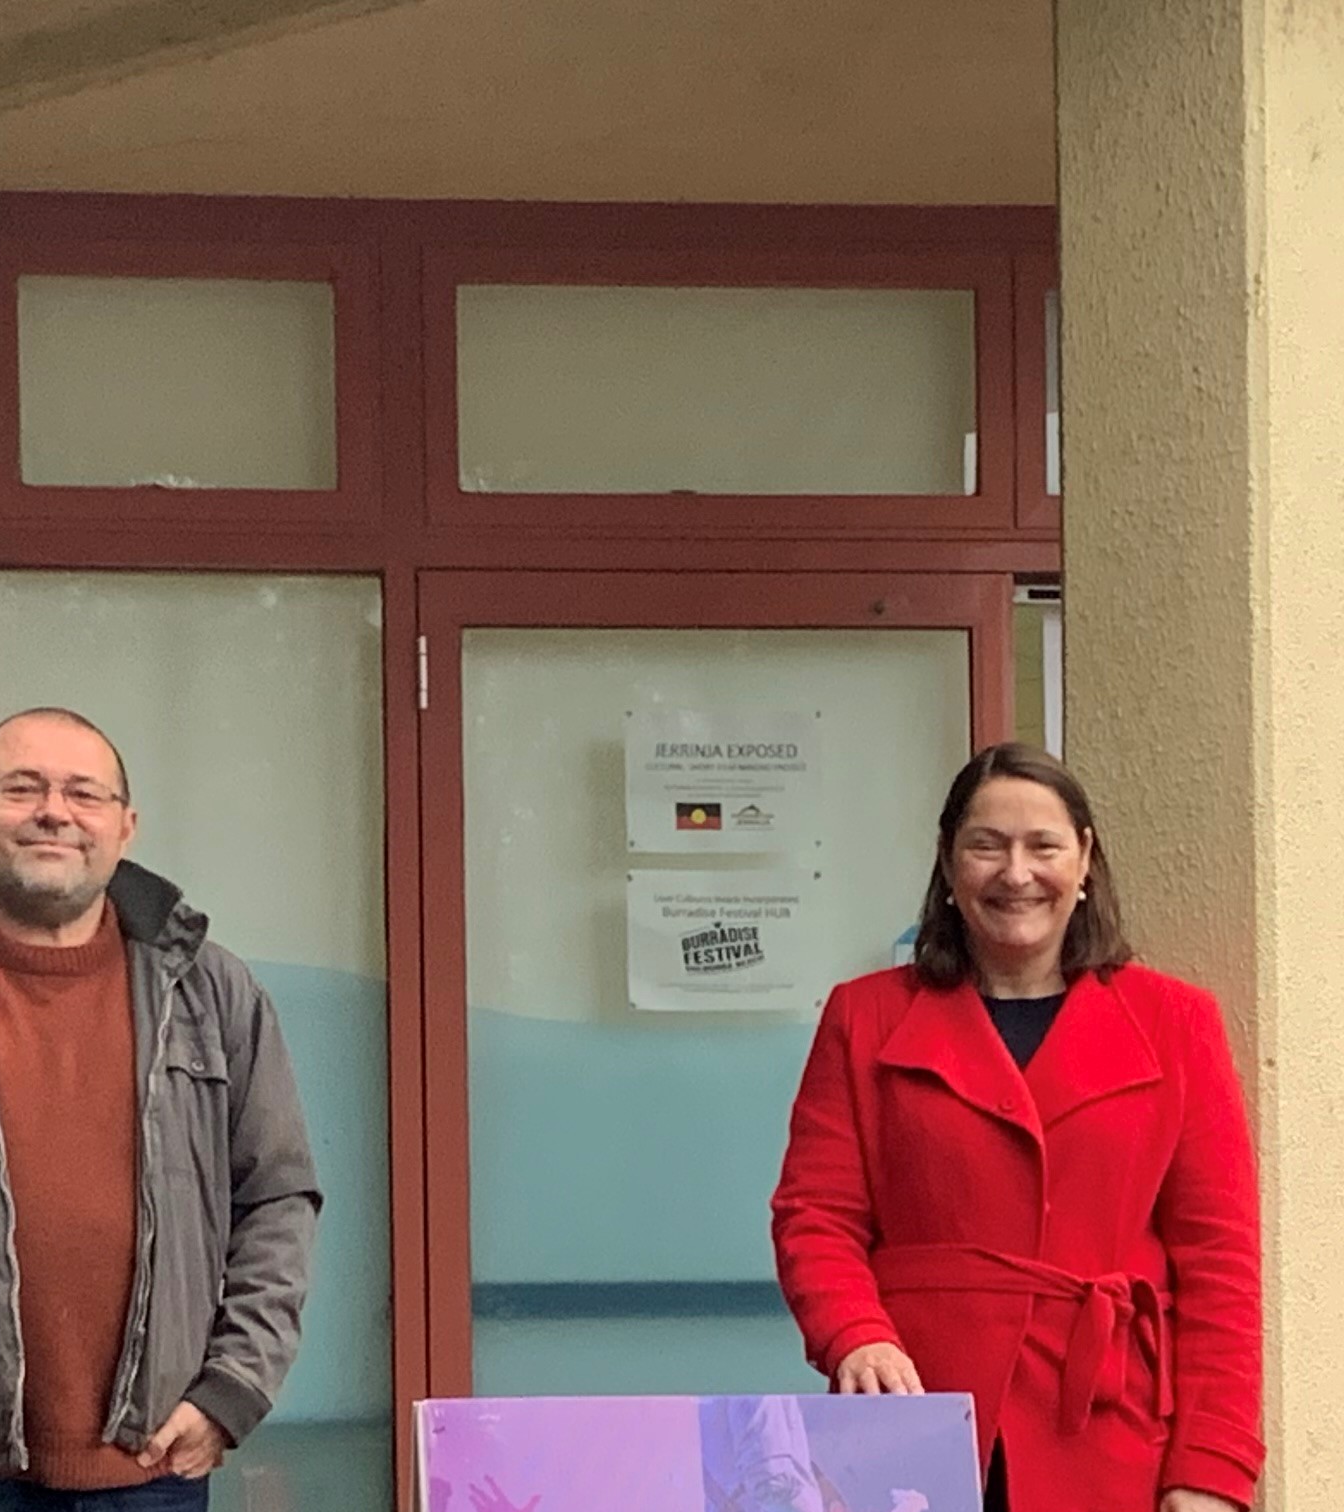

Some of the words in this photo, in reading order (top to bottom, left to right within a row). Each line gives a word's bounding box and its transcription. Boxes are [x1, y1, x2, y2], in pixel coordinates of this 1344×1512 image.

[727, 742, 799, 759] EXPOSED
[681, 926, 760, 952] BURRADISE
[683, 942, 764, 965] FESTIVAL
